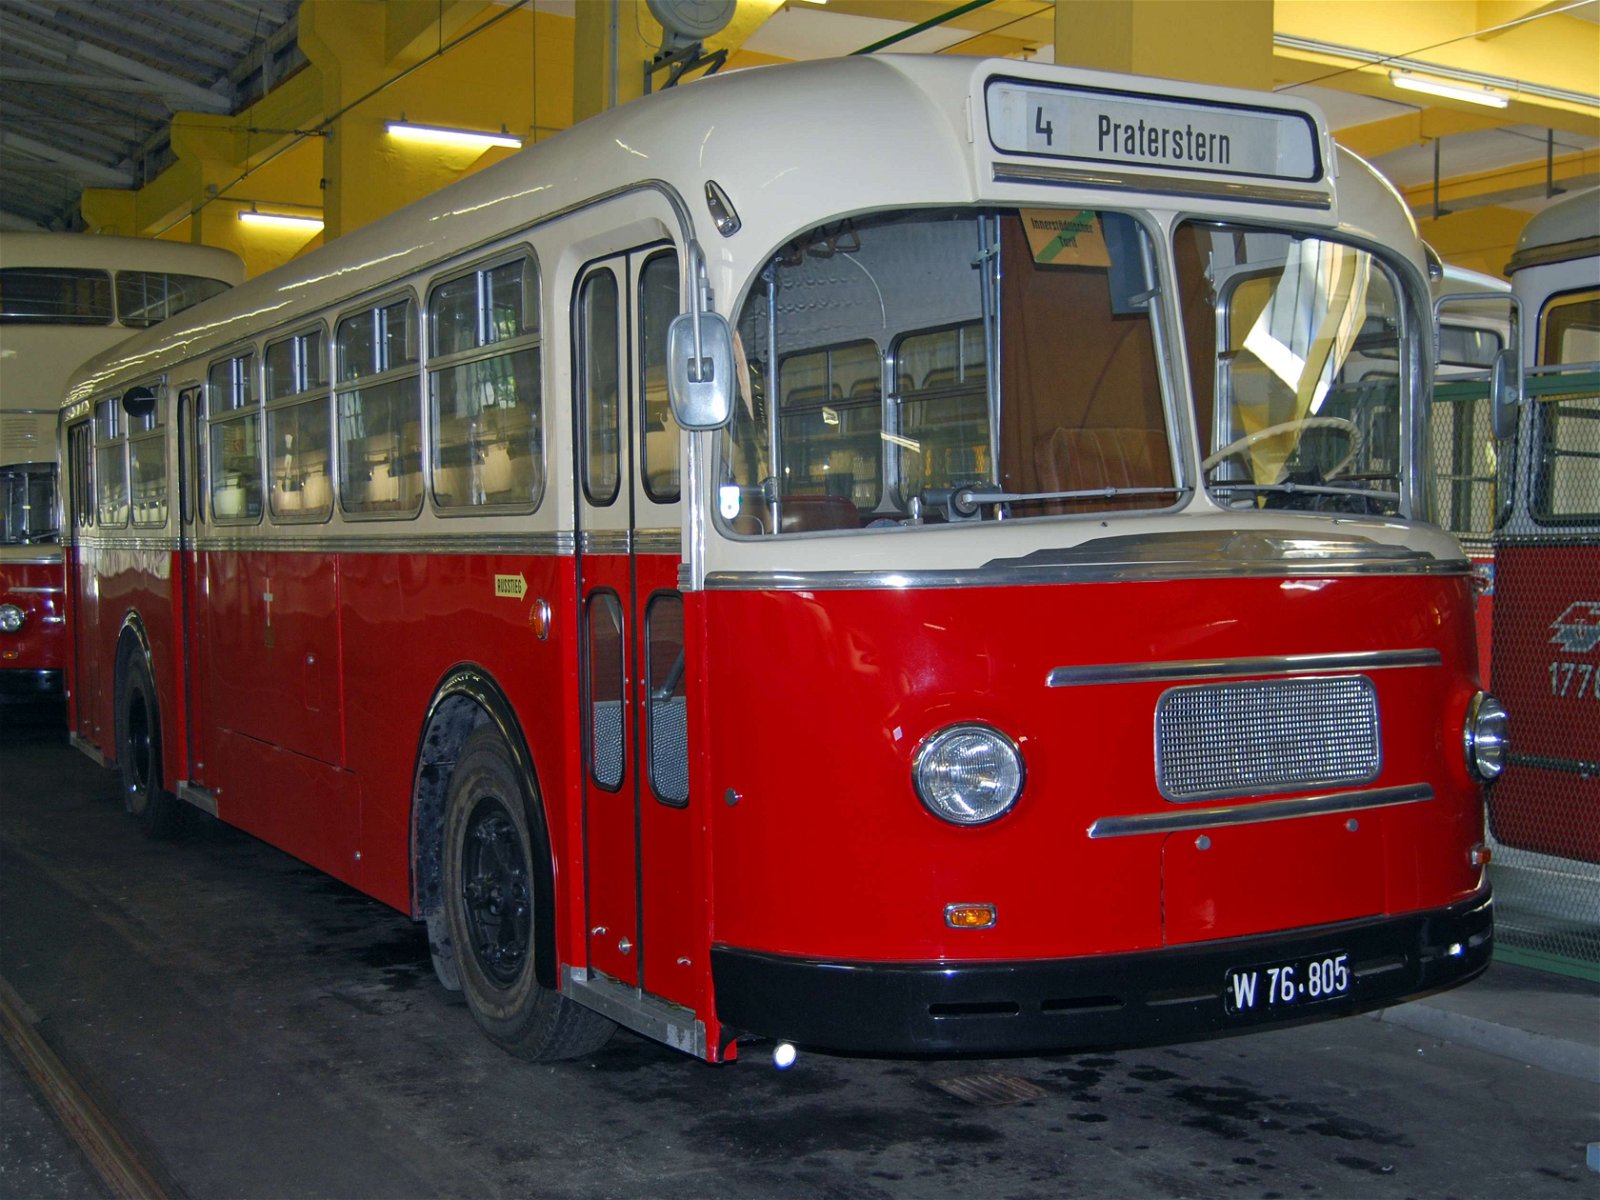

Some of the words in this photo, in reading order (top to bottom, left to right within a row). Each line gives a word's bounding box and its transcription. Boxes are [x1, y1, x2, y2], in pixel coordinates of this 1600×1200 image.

[1035, 106, 1053, 146] 4
[1098, 114, 1230, 165] Praterstern
[497, 578, 522, 594] AUSSTIEG
[1233, 971, 1257, 1009] W
